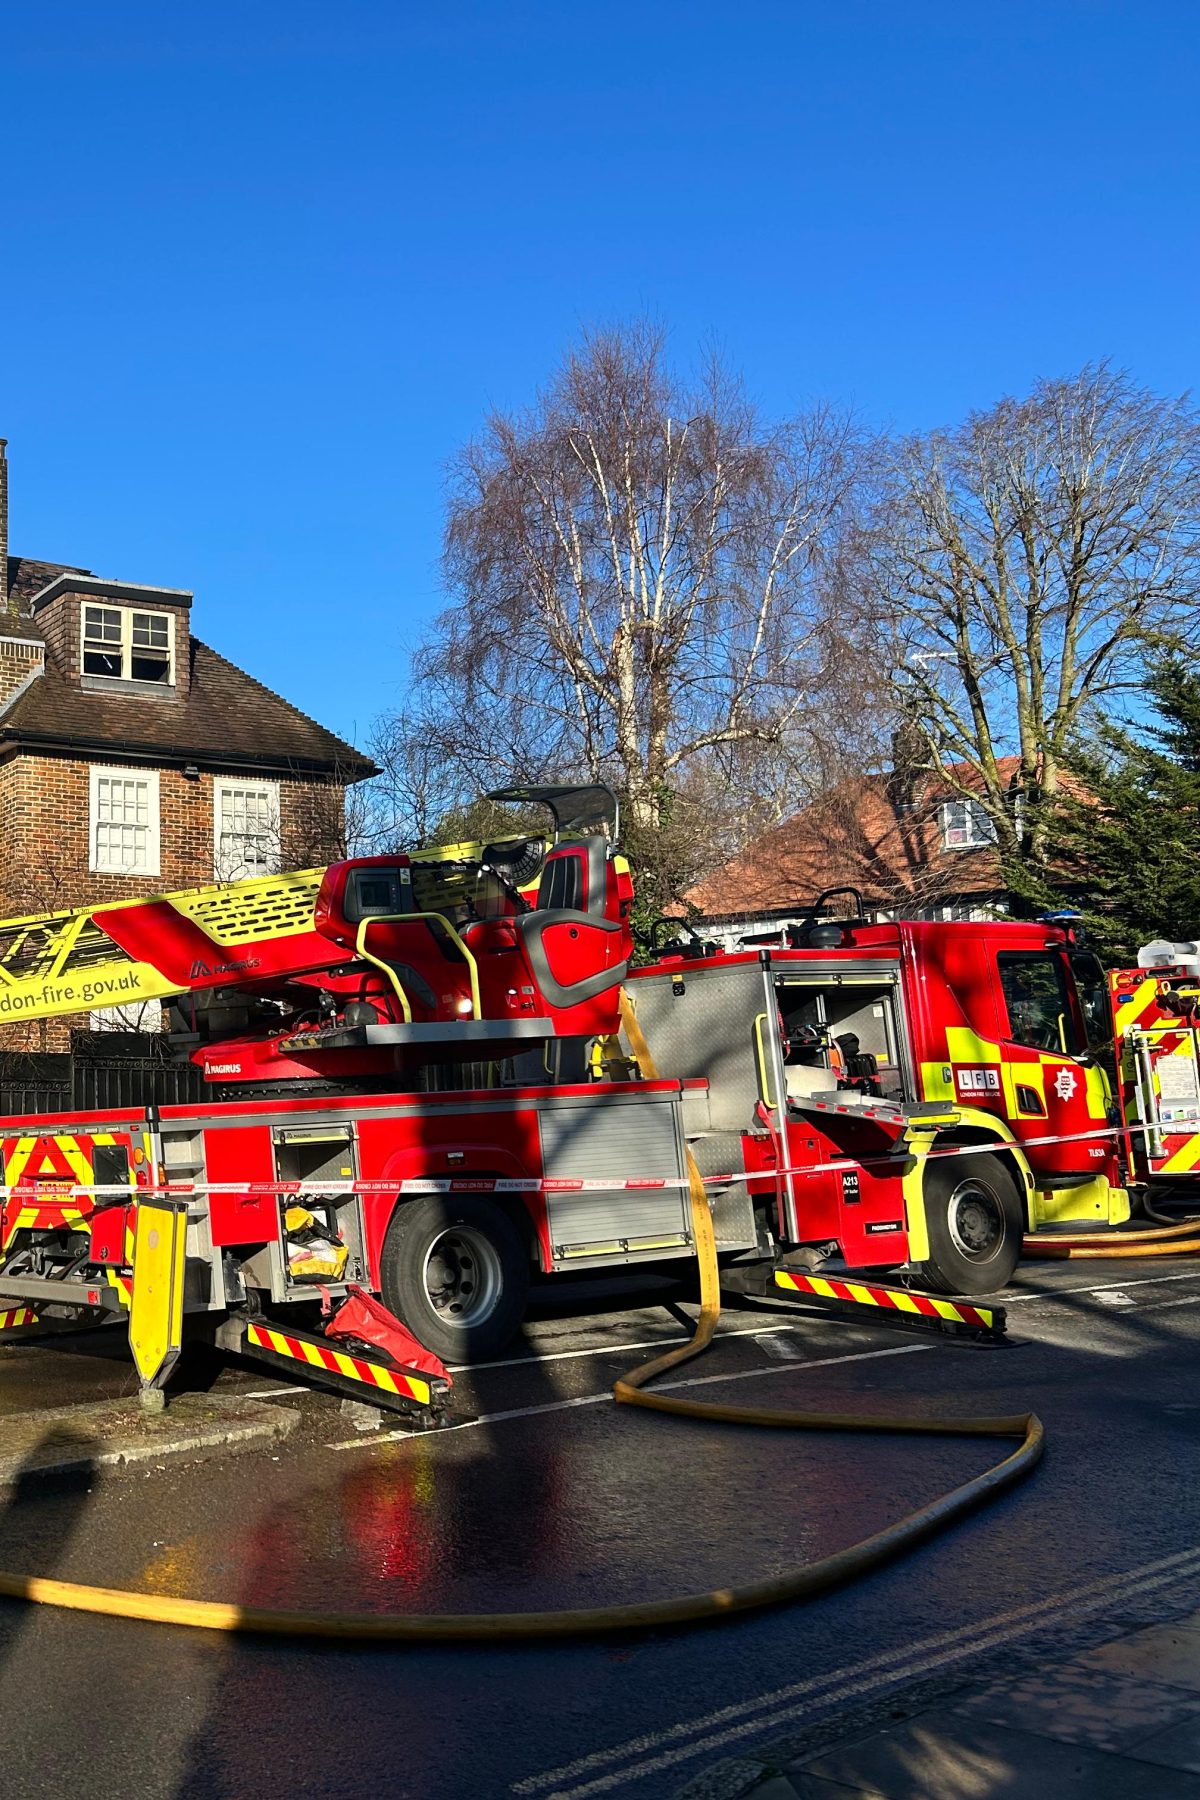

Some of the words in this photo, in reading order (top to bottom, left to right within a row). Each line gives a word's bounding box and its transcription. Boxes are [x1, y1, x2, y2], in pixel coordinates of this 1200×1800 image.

[214, 959, 261, 974] MAGIRUS
[210, 1063, 241, 1074] MAGIRUS
[842, 1176, 859, 1187] A213
